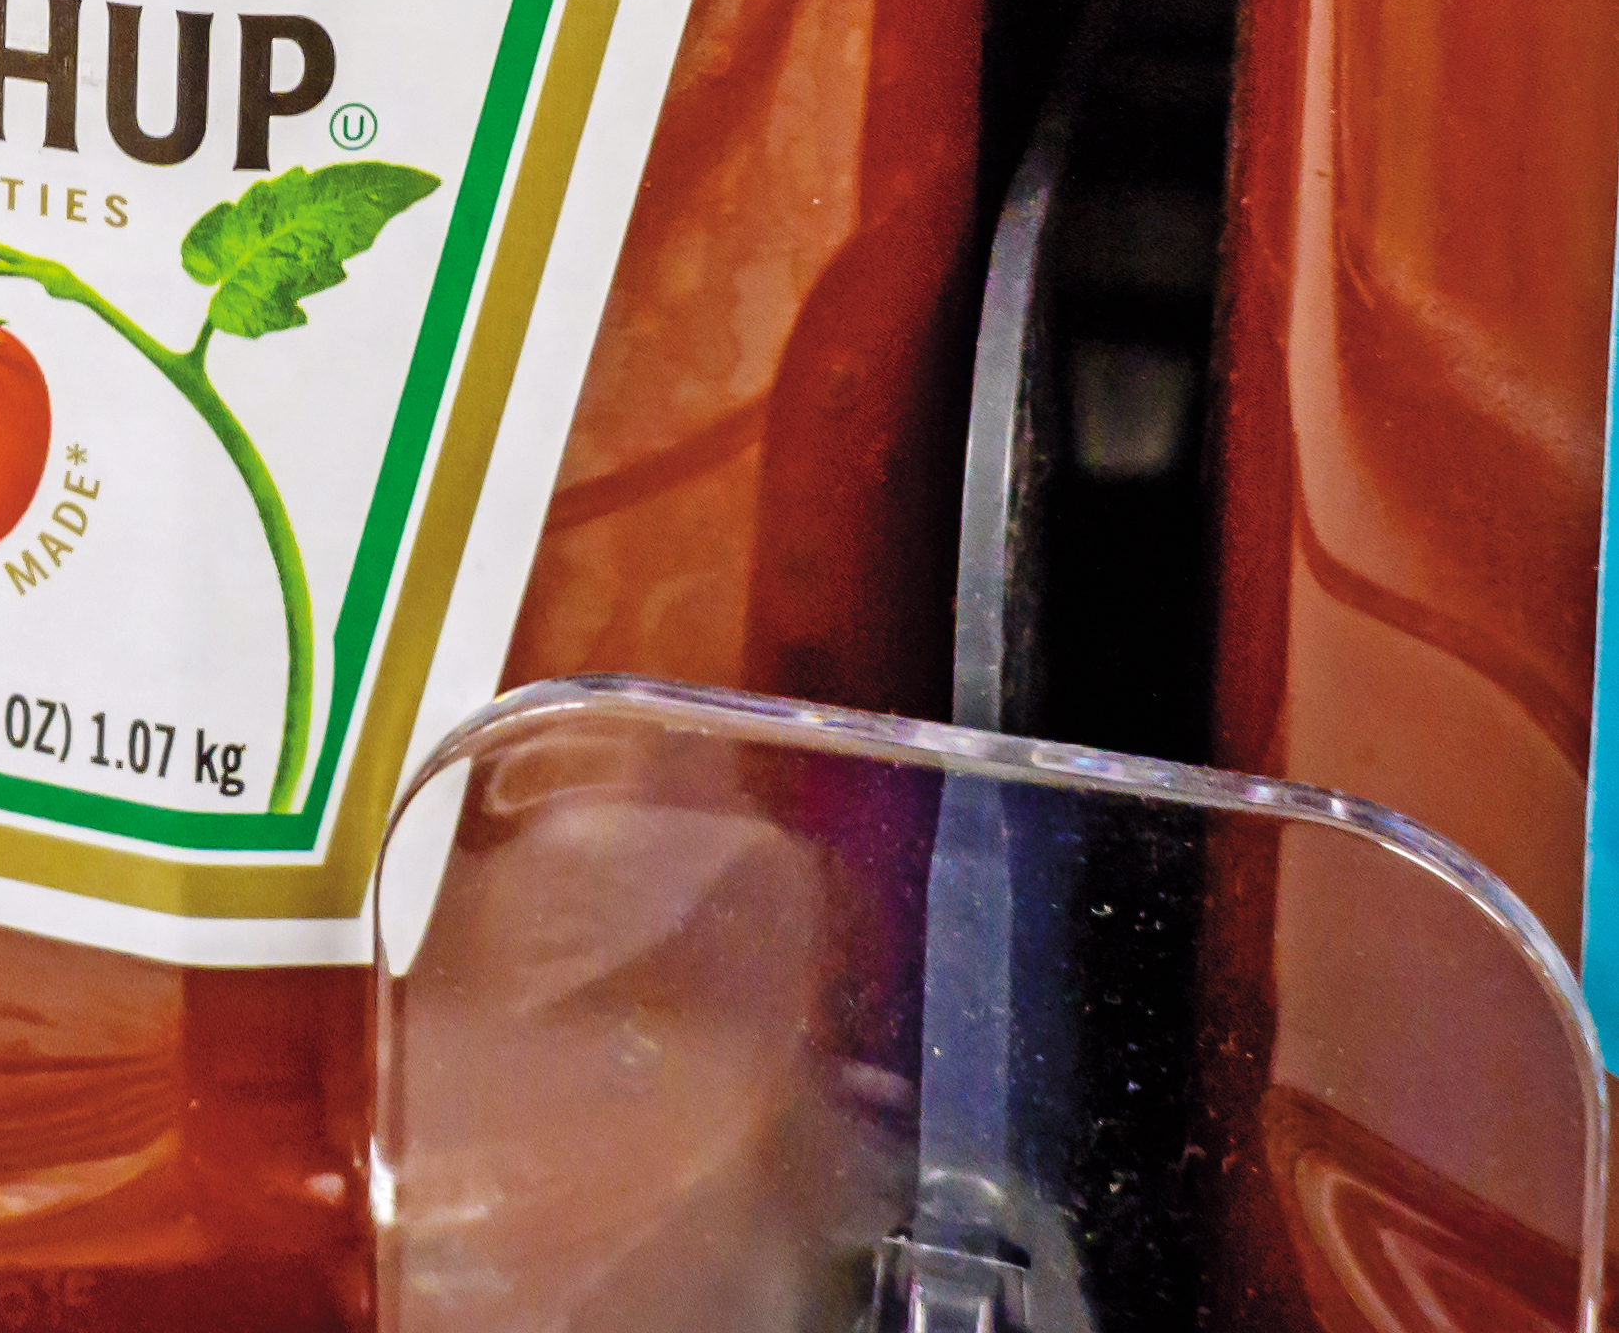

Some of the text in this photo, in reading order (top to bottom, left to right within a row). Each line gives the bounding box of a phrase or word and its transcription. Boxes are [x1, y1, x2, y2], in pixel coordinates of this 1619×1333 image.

[4, 692, 73, 764] OZ)
[89, 711, 177, 779] 1.07
[194, 727, 248, 797] kg
